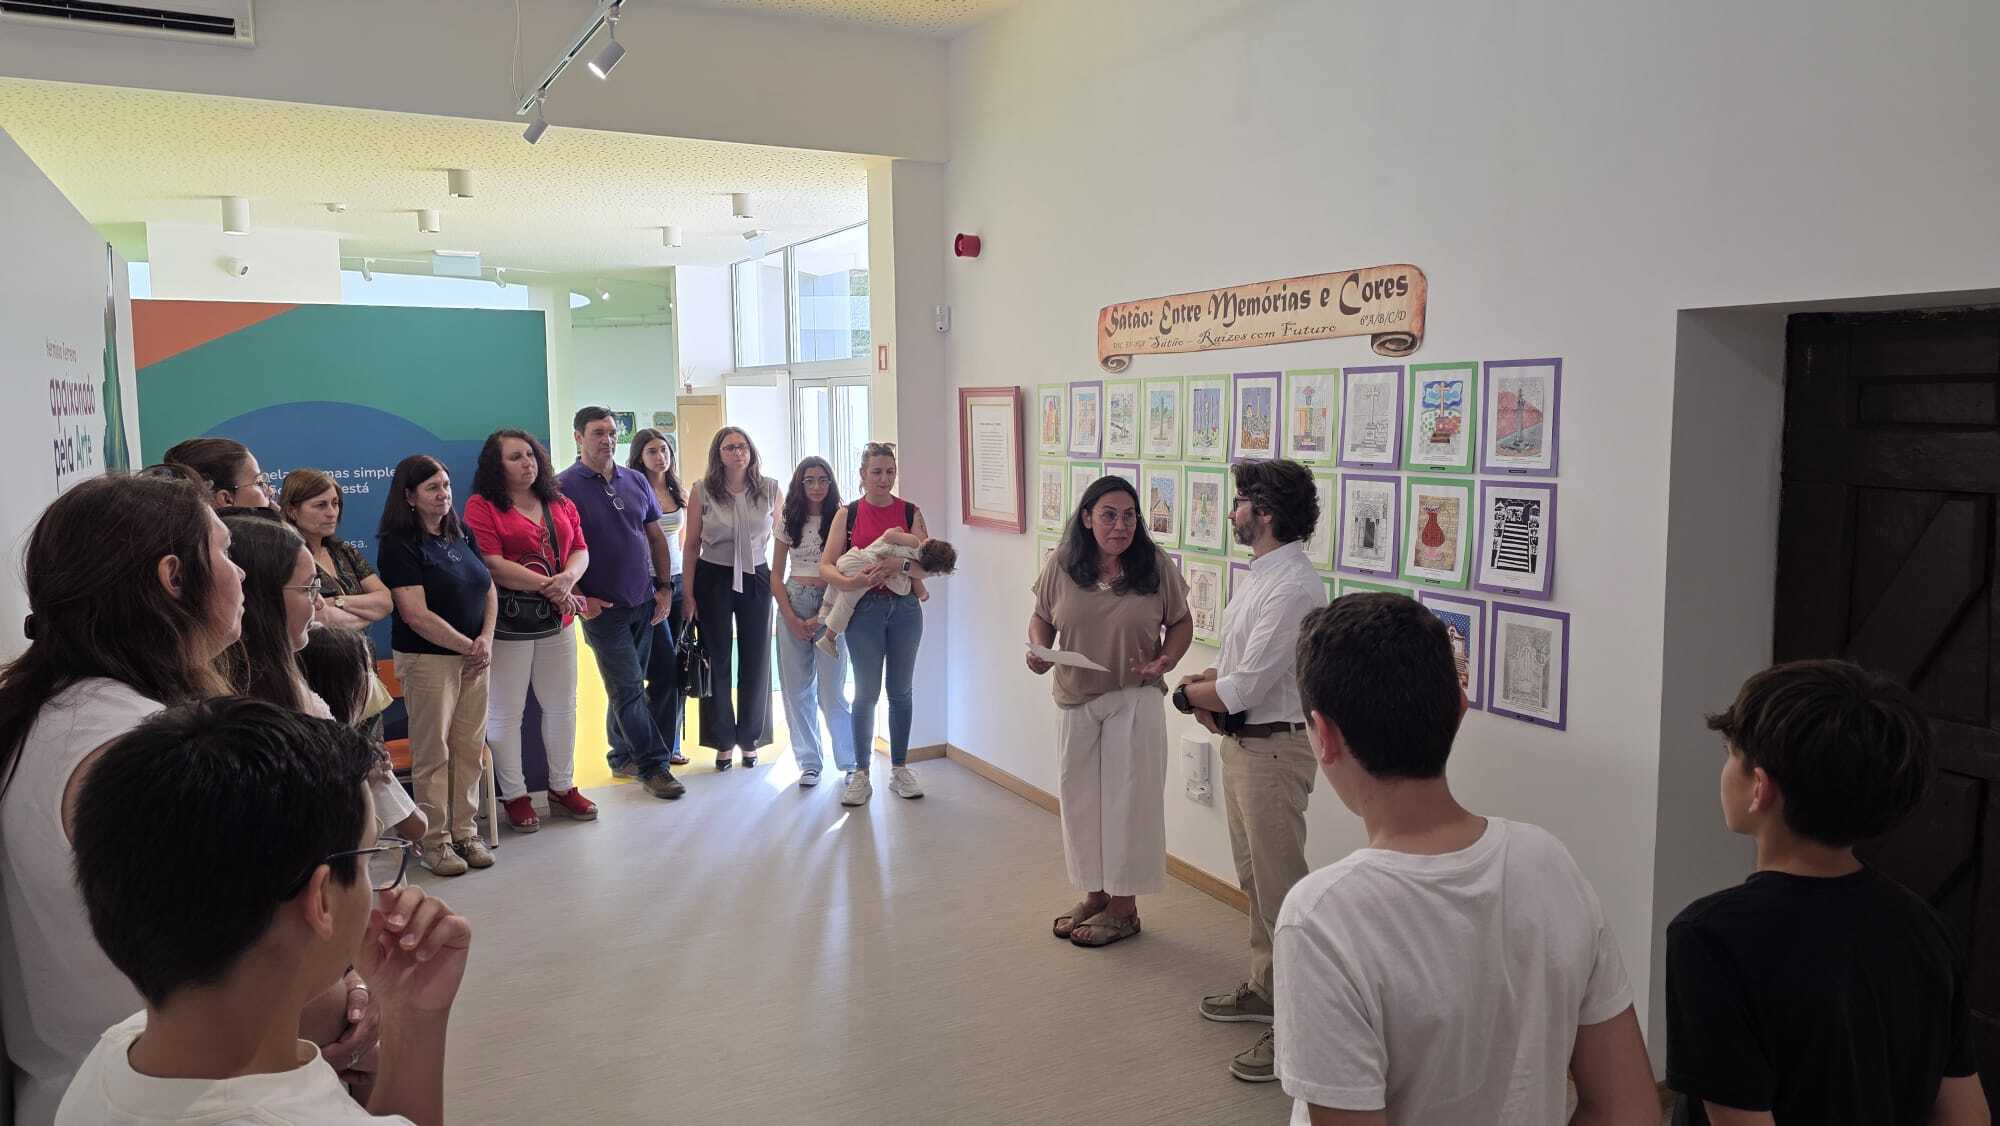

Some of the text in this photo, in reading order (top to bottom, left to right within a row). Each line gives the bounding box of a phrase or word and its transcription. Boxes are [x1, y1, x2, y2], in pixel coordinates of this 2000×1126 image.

[1159, 300, 1201, 335] Entre
[1207, 284, 1311, 328] Memórias
[1319, 287, 1331, 308] e
[1339, 272, 1409, 316] Cores
[1250, 331, 1276, 342] com
[1281, 320, 1337, 338] Futuro
[49, 373, 96, 434] apaixonado
[53, 424, 93, 495] pela Arte
[353, 466, 397, 480] simple
[342, 481, 369, 494] está
